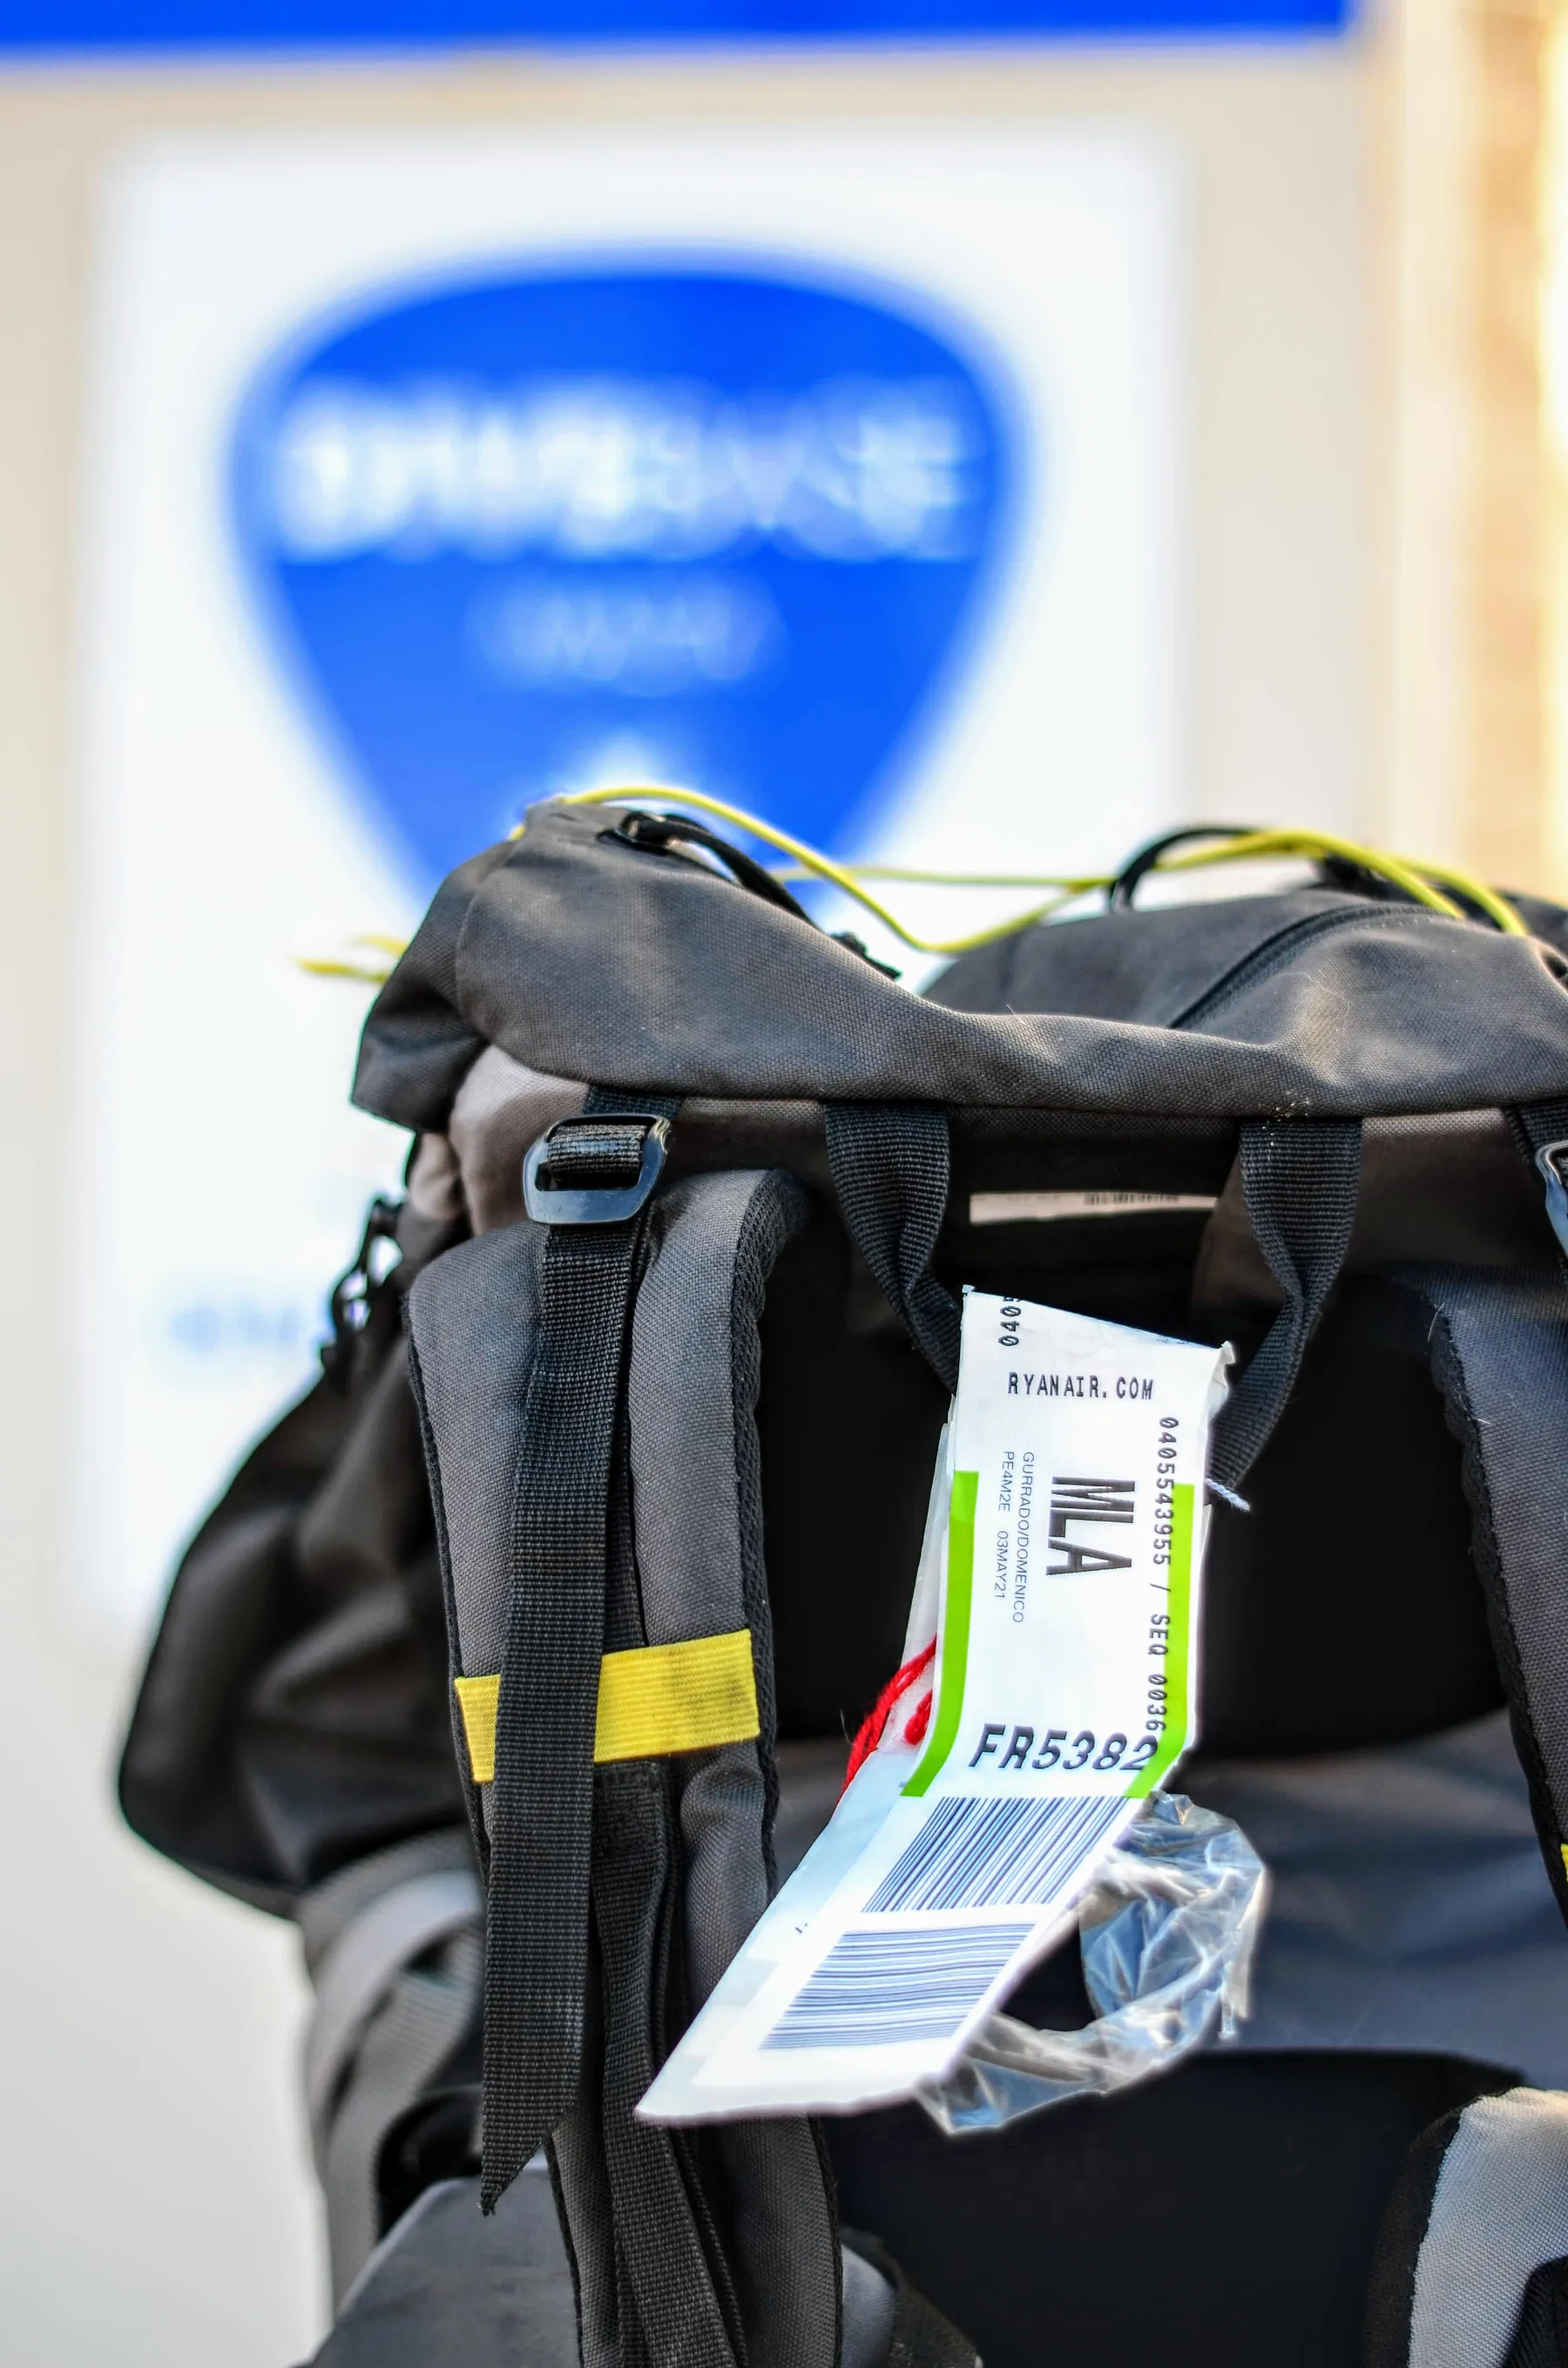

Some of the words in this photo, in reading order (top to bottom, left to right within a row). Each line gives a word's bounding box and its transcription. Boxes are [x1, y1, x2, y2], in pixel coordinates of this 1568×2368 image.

[1008, 1372, 1154, 1400] RYANAIR.COM
[998, 1451, 1015, 1512] PE4M2E
[1152, 1417, 1179, 1565] 0405543955
[1012, 1452, 1035, 1623] GURRADO/DOMENICO
[1046, 1477, 1135, 1576] MLA
[994, 1531, 1009, 1599] 03MAY21
[1149, 1614, 1170, 1655] SEQ
[1146, 1674, 1168, 1731] 0036
[968, 1724, 1158, 1770] FR5382
